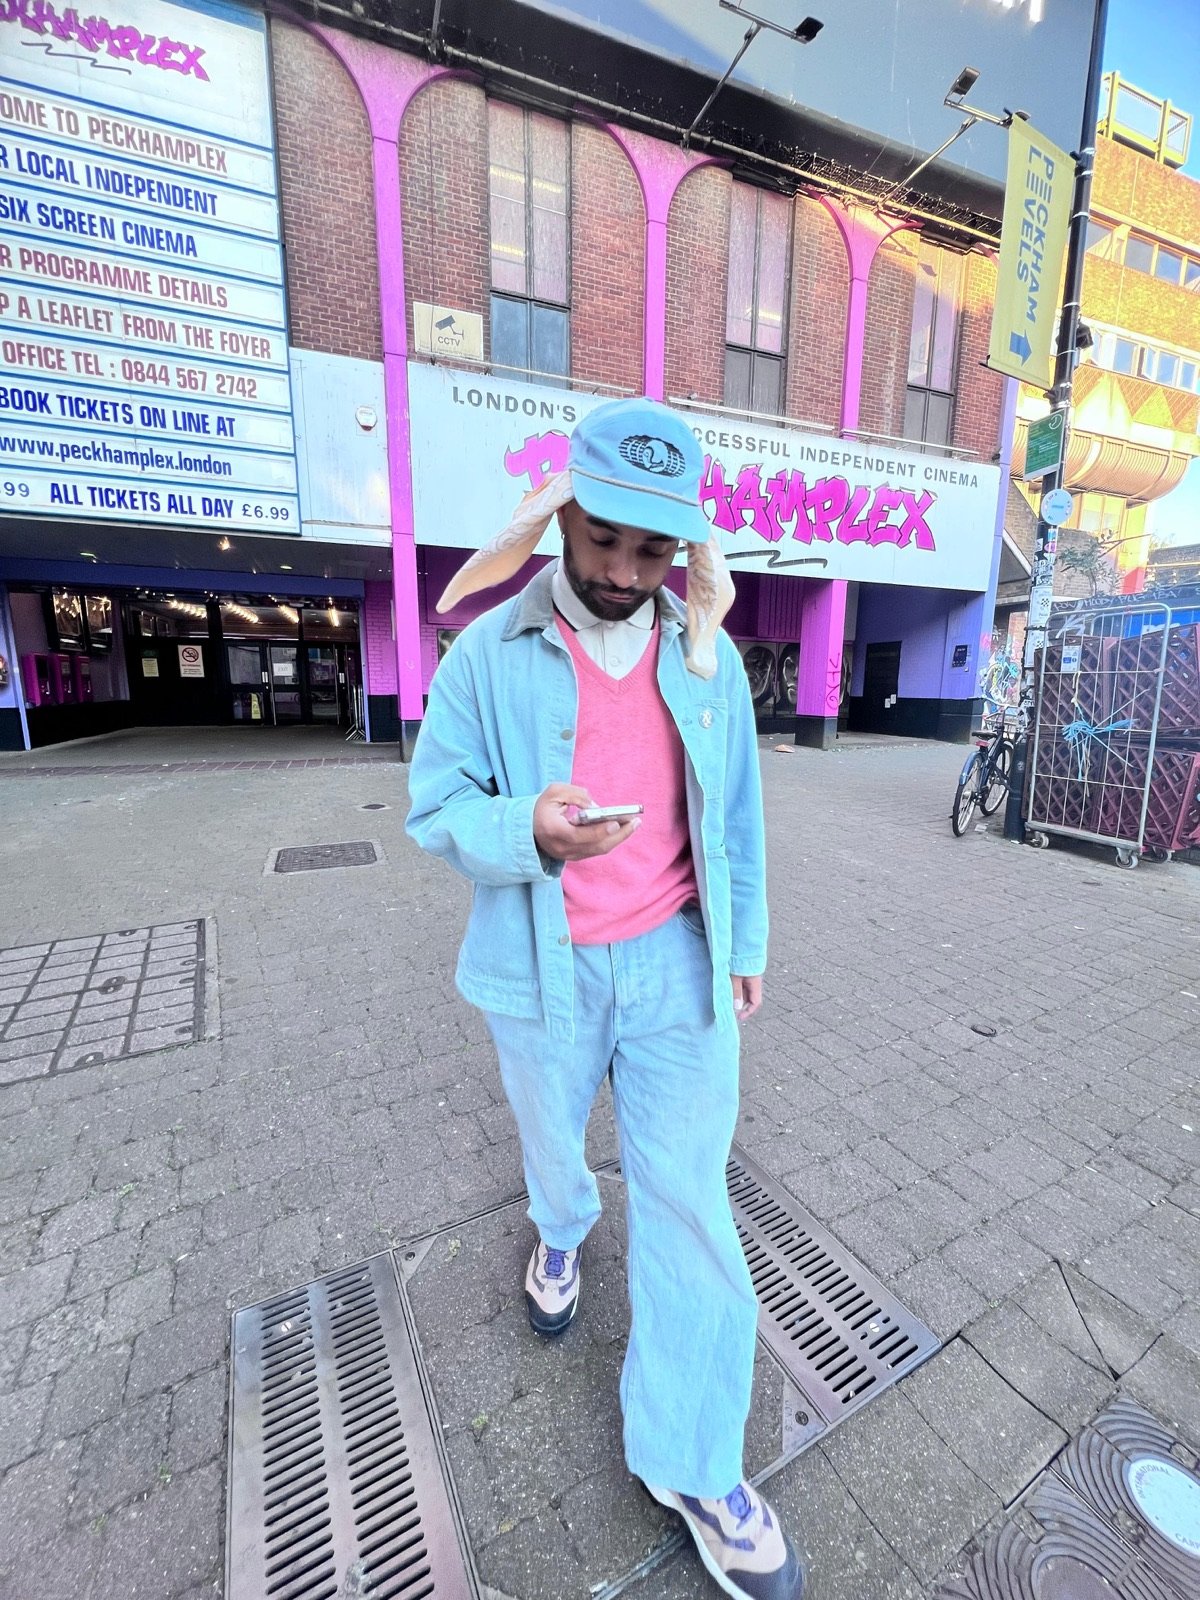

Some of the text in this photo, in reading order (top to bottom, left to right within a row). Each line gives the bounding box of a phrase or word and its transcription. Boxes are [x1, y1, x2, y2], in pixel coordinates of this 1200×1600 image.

[52, 106, 80, 136] TO
[88, 115, 228, 174] PECKHAMPLEX
[15, 148, 80, 186] LOCAL
[85, 164, 218, 216] INDEPENDENT
[0, 194, 198, 258] SIX SCREEN CINEMA
[1017, 145, 1042, 283] LEVELS
[1026, 153, 1055, 324] PECKHAM
[19, 247, 152, 295] PROGRAMME
[158, 274, 228, 308] DETAILS
[18, 296, 32, 320] A
[37, 299, 114, 333] LEAFLET
[122, 313, 177, 343] FROM
[182, 324, 215, 350] THE
[219, 330, 272, 359] FOYER
[437, 336, 461, 346] CCTV
[2, 340, 67, 371] OFFICE
[121, 358, 170, 386] 0844
[176, 367, 208, 391] 567
[215, 373, 258, 399] 2742
[0, 386, 236, 437] BOOK TICKETS ON LINE AT
[452, 386, 979, 488] LONDON'S CCESSFUL INDEPENDENT CINEMA
[0, 434, 232, 476] www.peckhamplex.london
[50, 482, 83, 506] ALL
[87, 486, 161, 512] TICKETS
[167, 491, 197, 515] ALL
[202, 497, 234, 518] DAY
[241, 503, 289, 520] £6.99
